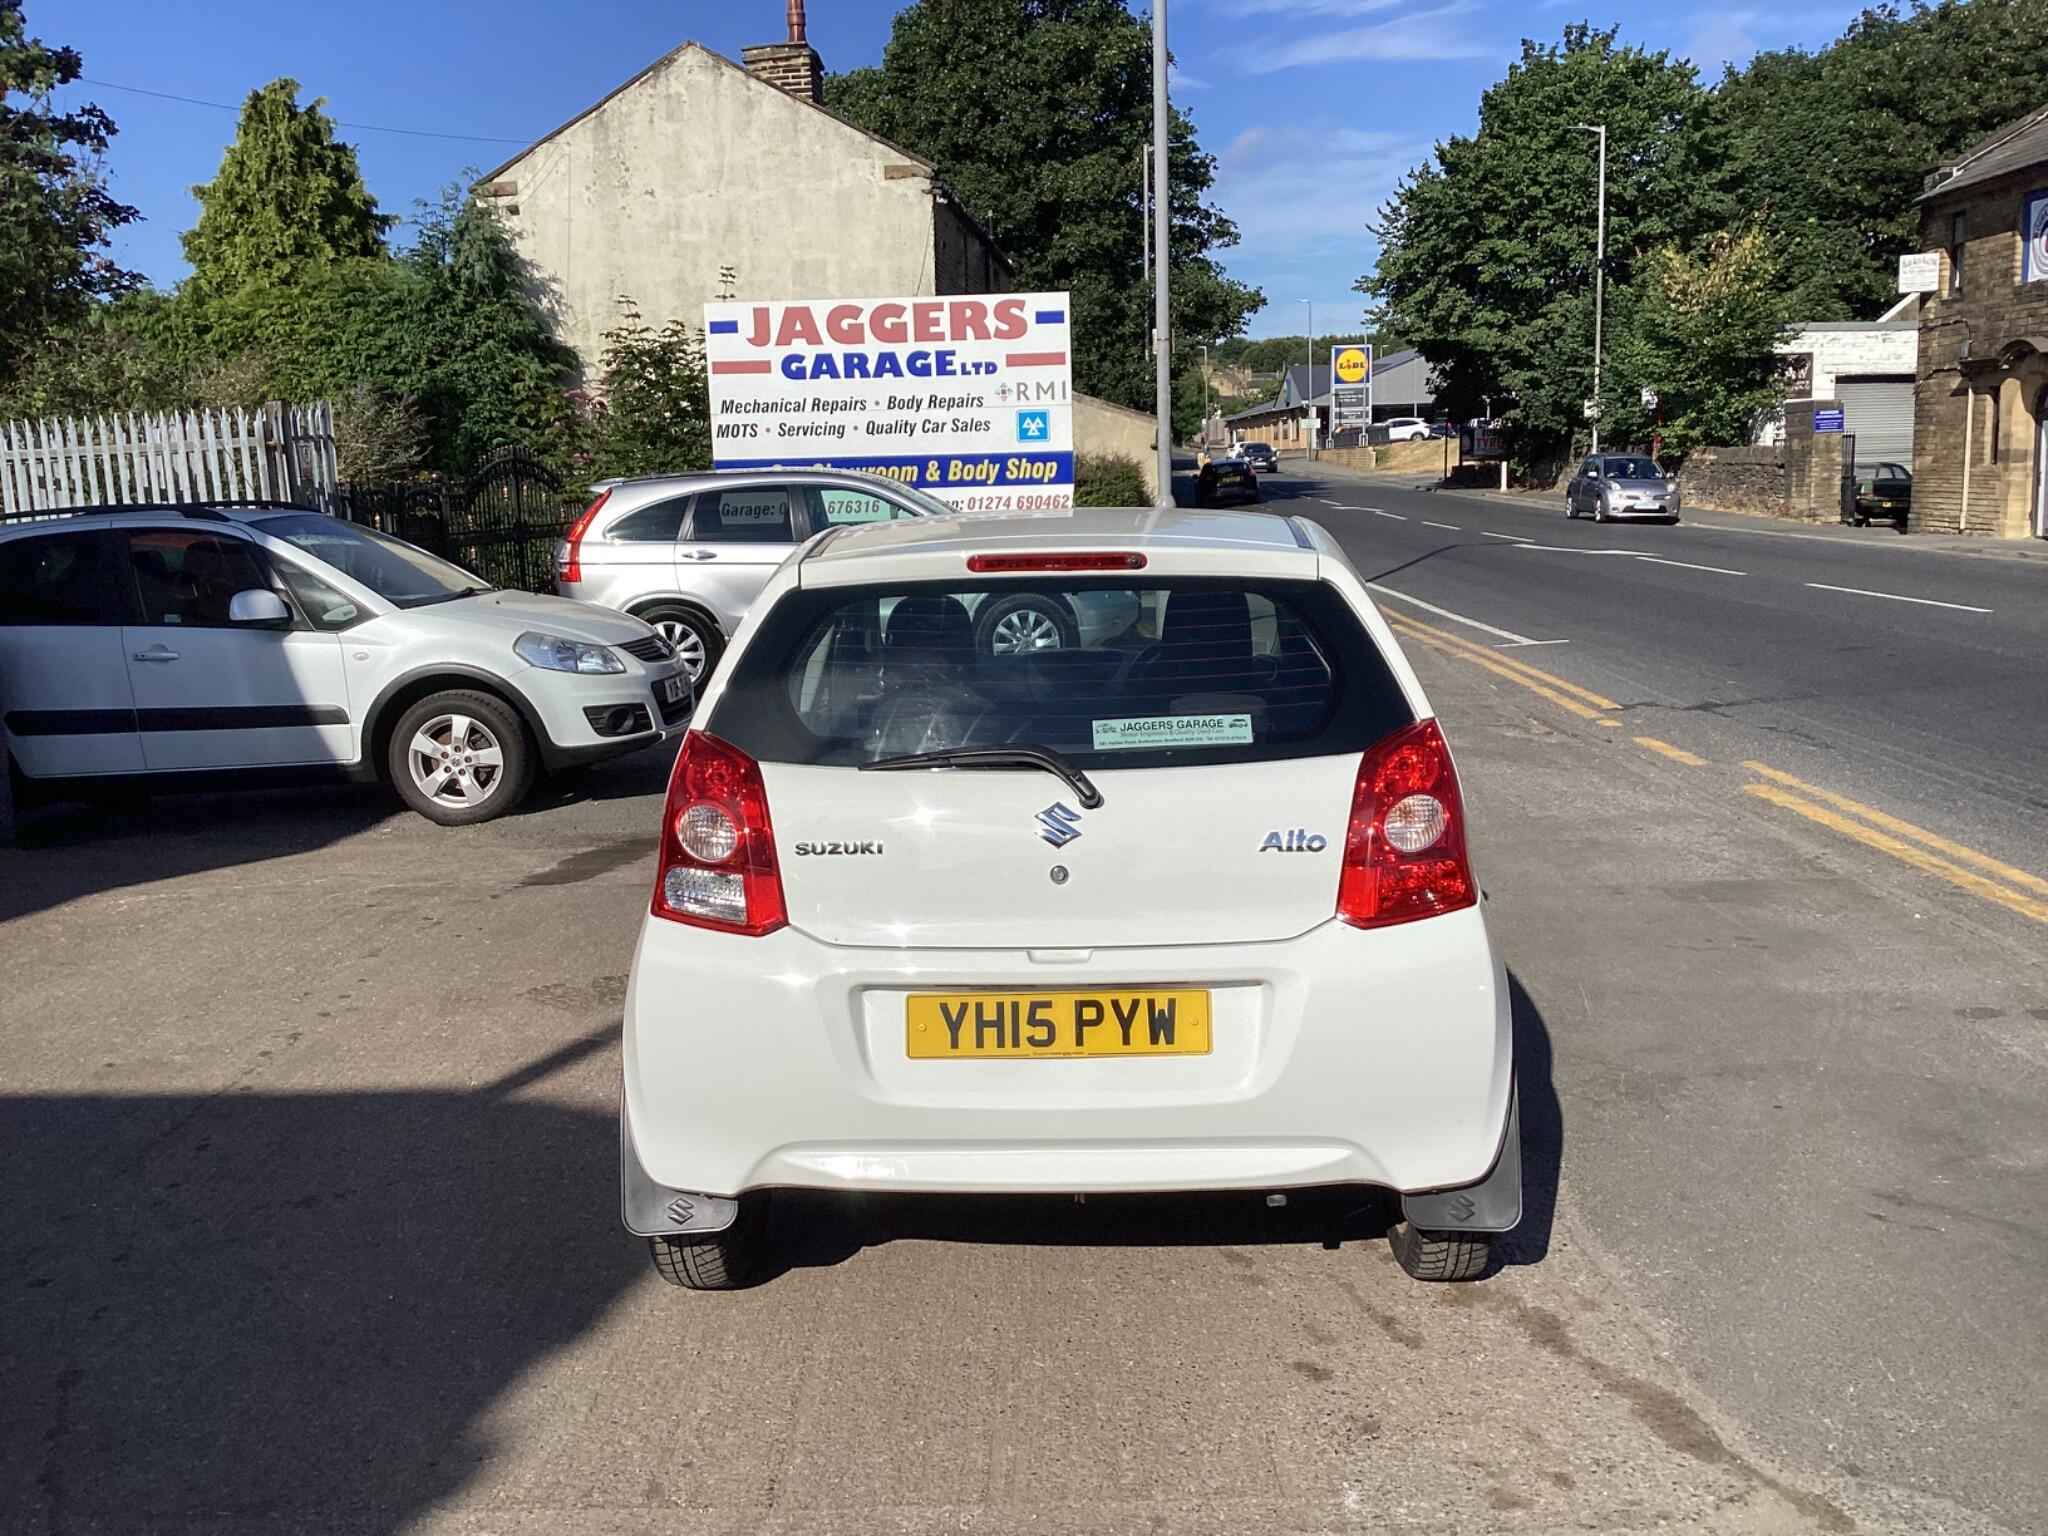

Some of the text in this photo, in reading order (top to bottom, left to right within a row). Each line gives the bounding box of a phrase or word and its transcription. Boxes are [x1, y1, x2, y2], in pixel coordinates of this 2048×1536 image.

[746, 298, 1029, 347] JAGGERS
[781, 349, 998, 380] GARAGE LTD
[1016, 380, 1067, 401] RMI
[720, 393, 984, 415] Mechanical Repairs Body Repairs
[716, 417, 991, 439] MOTS Servicing Quality Car Sales
[926, 460, 941, 481] &
[948, 459, 1000, 484] Body
[1005, 457, 1057, 482] Shop
[721, 503, 775, 519] Garage:
[827, 500, 880, 514] 676316
[967, 497, 1012, 511] 01274
[1016, 494, 1070, 510] 690462
[1120, 718, 1224, 732] JAGGERS GARAGE
[794, 840, 884, 857] SUZUKI
[1259, 828, 1328, 853] Alto
[939, 997, 1177, 1050] YH15 PYW
